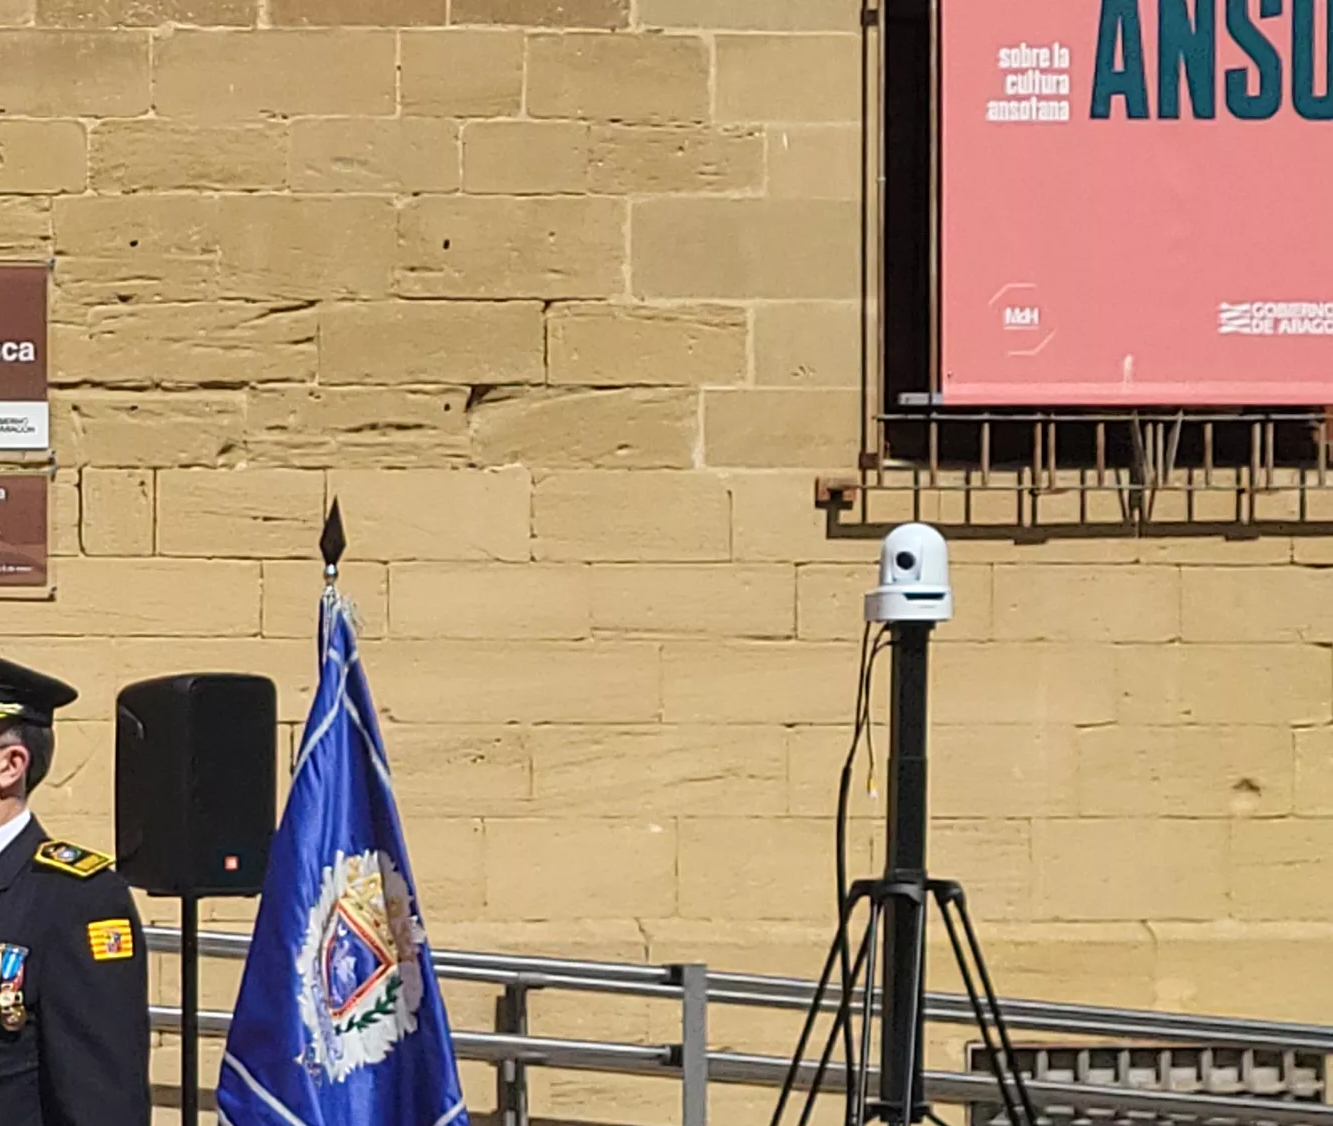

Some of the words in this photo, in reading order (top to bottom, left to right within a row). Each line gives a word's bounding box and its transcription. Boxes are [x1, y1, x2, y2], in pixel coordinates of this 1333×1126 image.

[998, 42, 1050, 68] sobre
[1053, 42, 1070, 68] la
[1005, 69, 1070, 95] cultura
[986, 96, 1070, 121] ansotana
